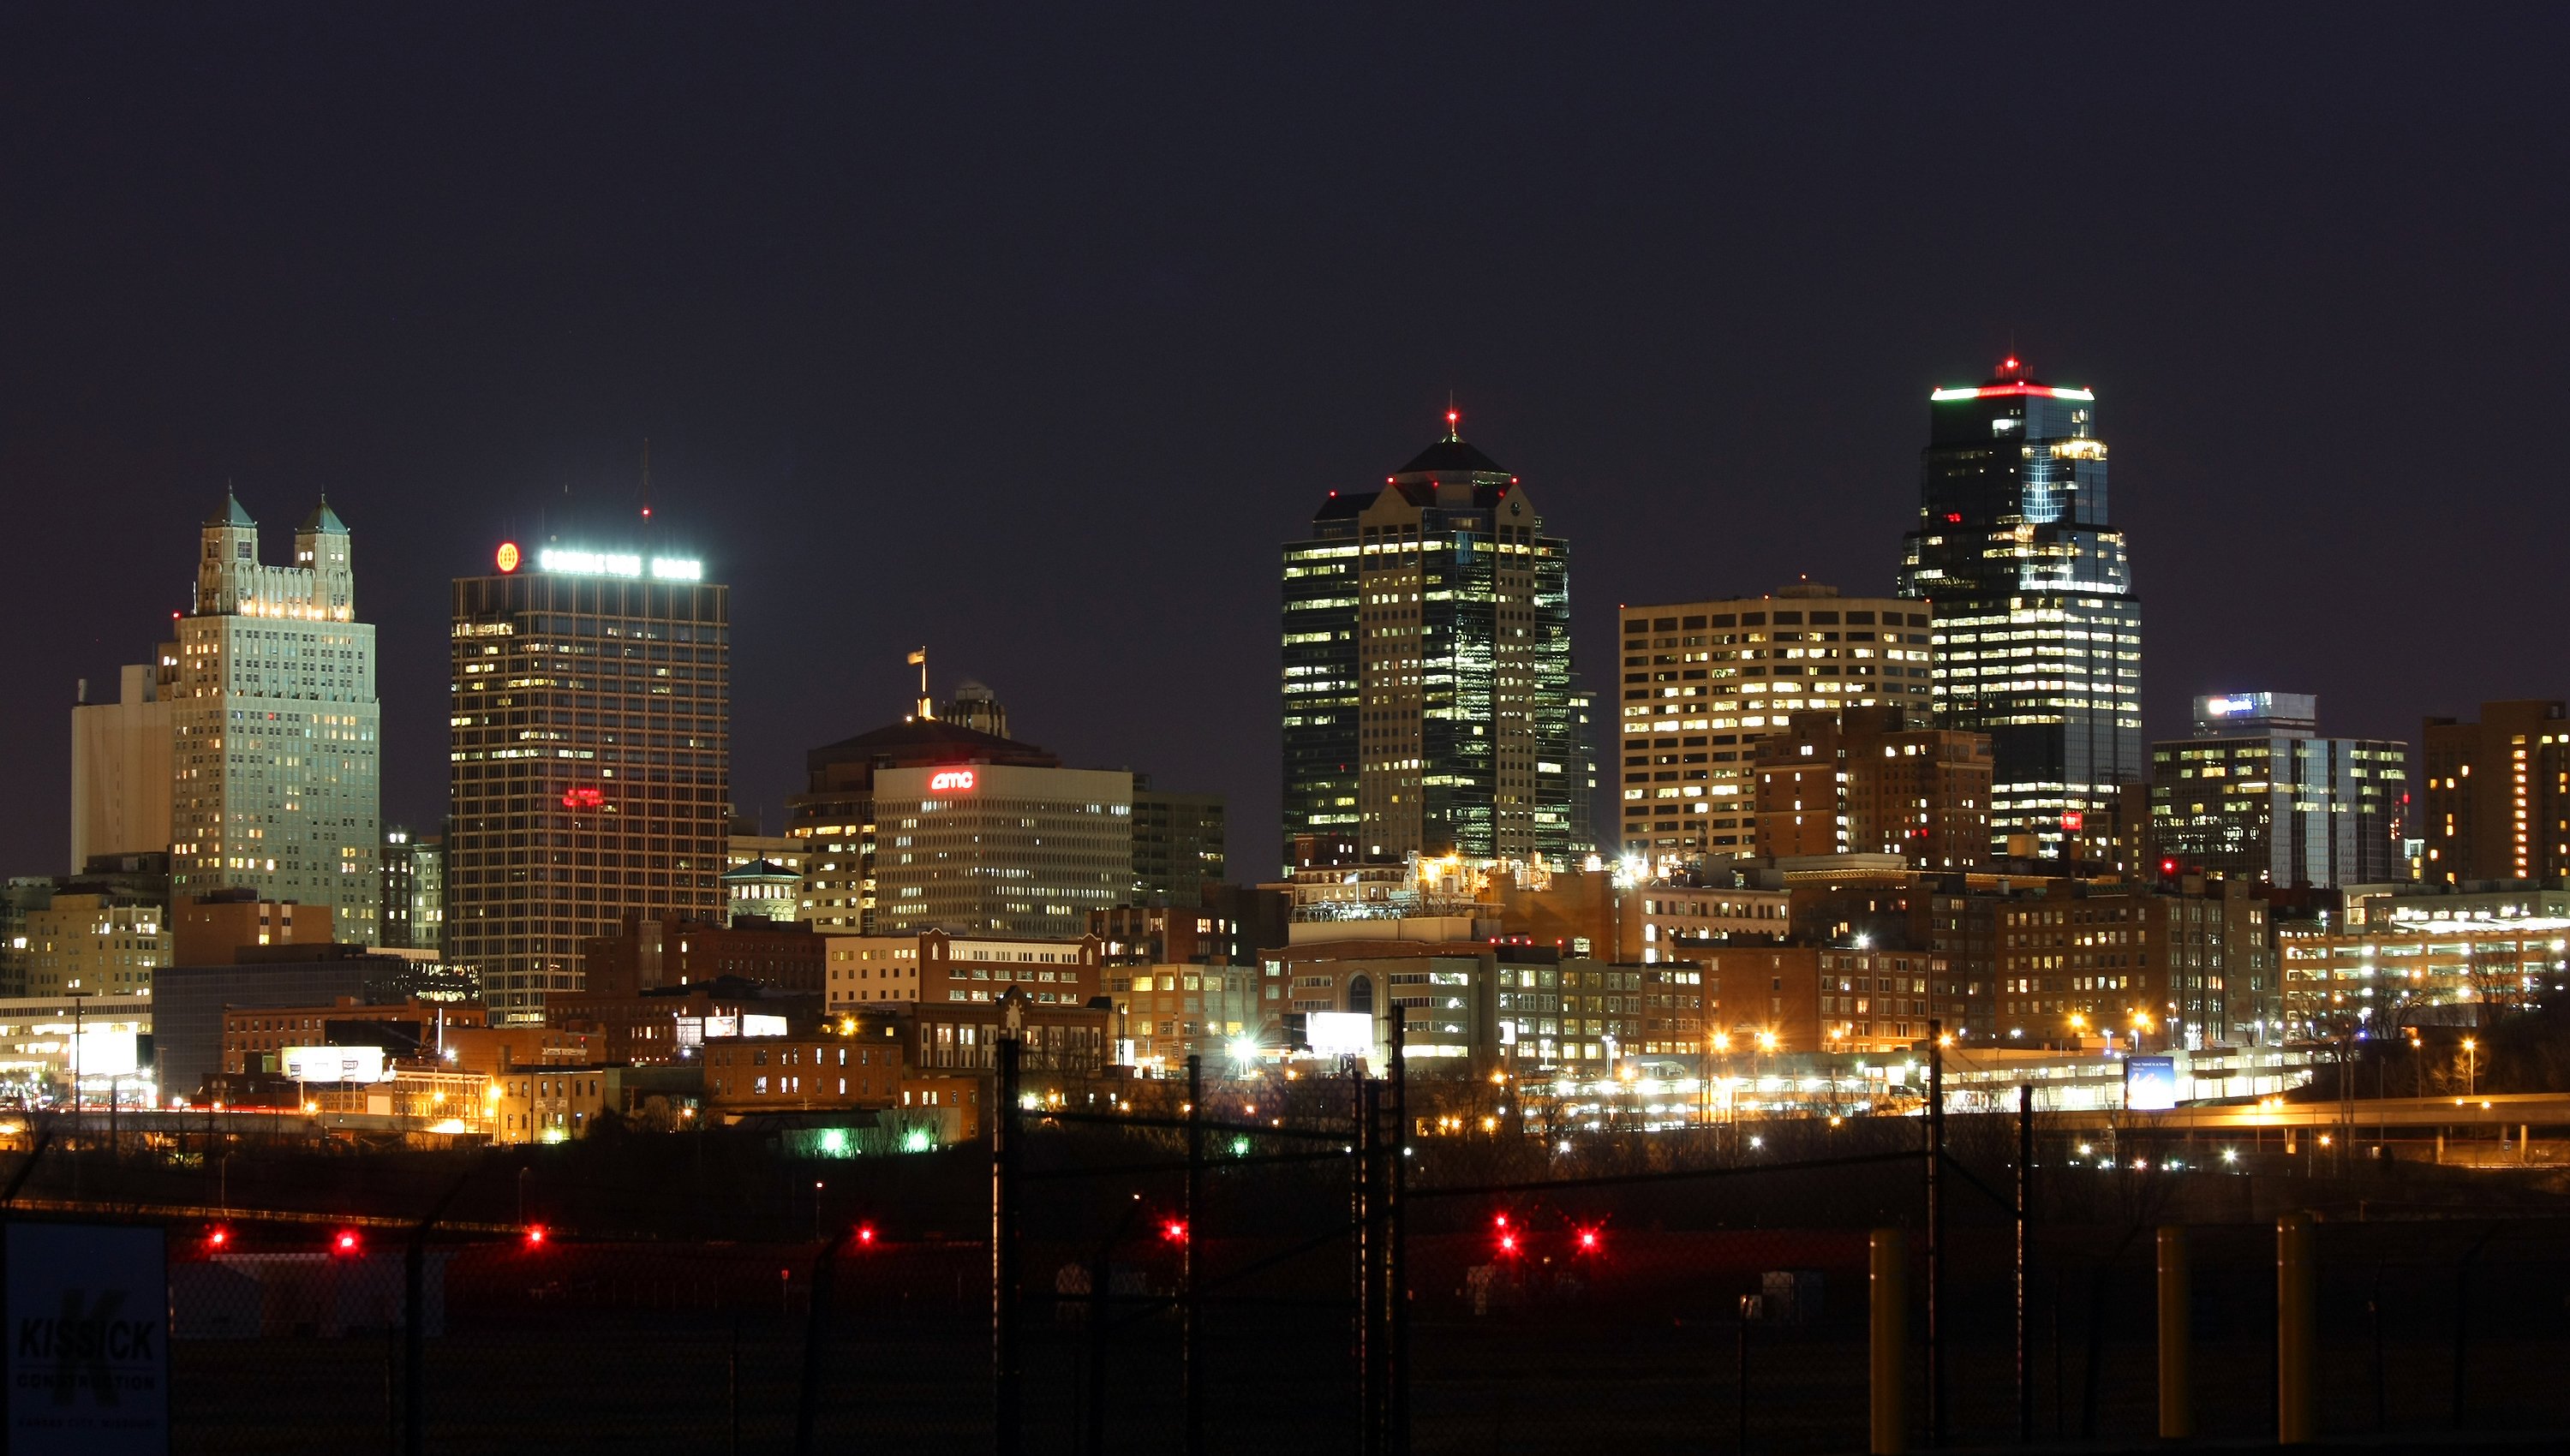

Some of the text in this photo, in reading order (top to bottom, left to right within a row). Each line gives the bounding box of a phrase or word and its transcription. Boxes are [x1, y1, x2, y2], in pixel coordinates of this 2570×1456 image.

[931, 772, 973, 790] amc
[18, 1319, 156, 1360] KISSICK
[17, 1375, 156, 1390] CONSTRUCTION
